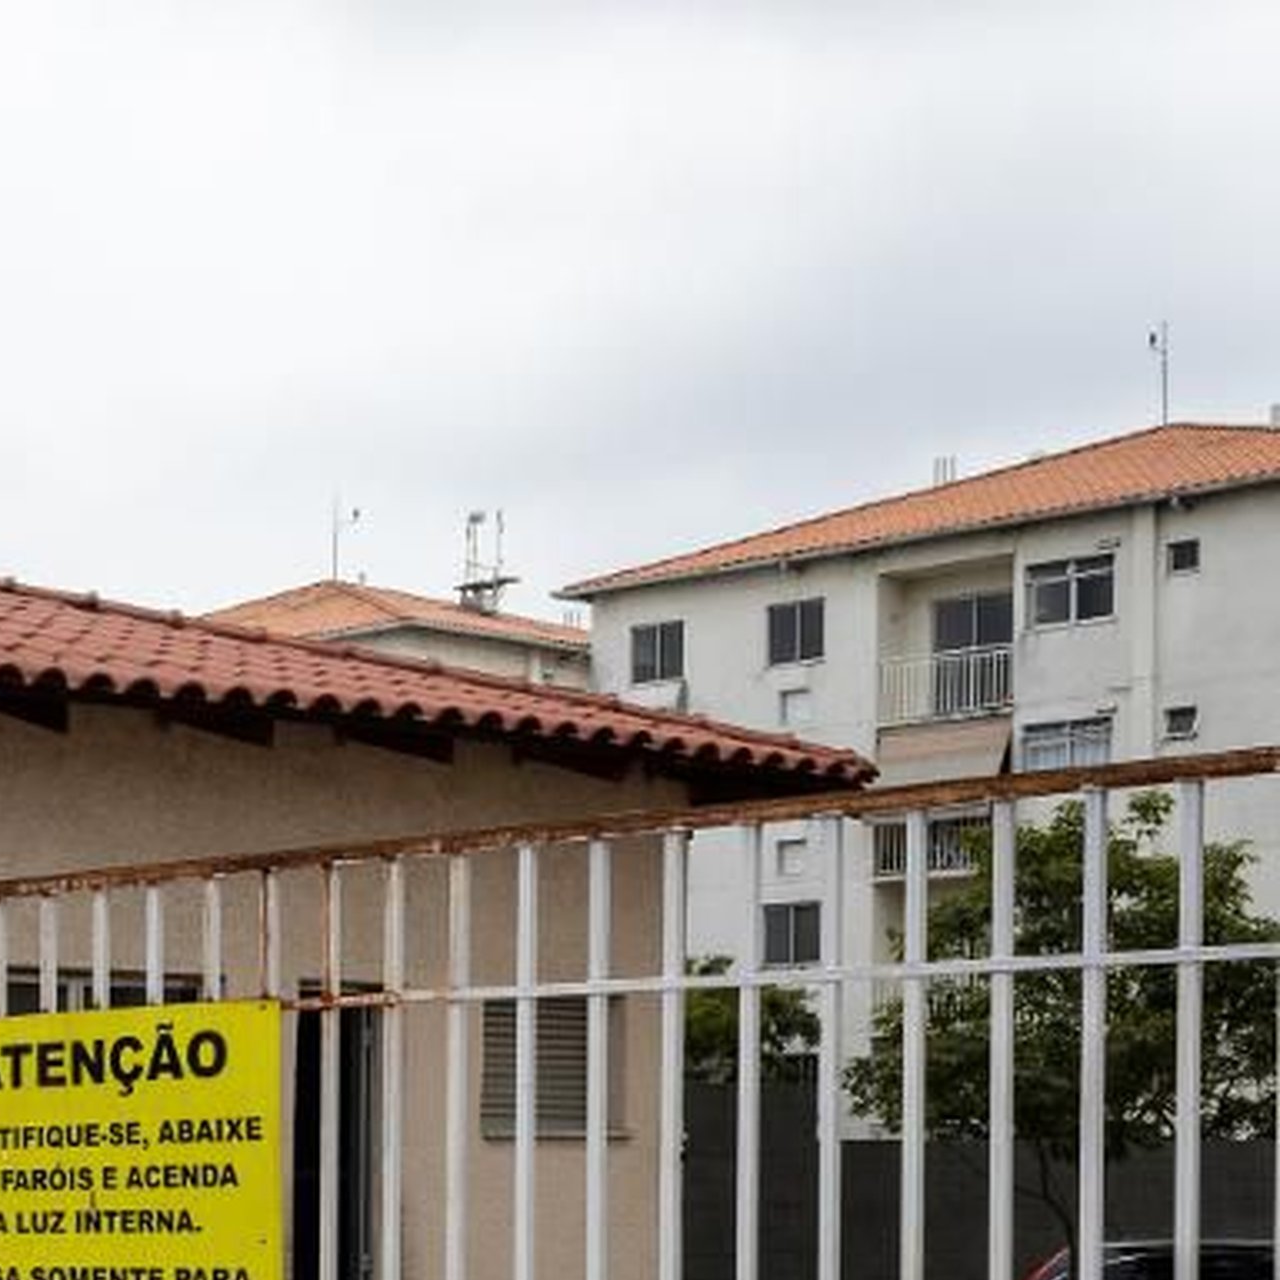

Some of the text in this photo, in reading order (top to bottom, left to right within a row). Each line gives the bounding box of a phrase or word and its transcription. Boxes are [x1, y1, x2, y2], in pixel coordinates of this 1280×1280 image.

[158, 1115, 263, 1144] ABAIXE
[1, 1161, 95, 1192] FARÓIS
[102, 1166, 118, 1190] E
[126, 1162, 239, 1190] ACENDA
[16, 1210, 67, 1235] LUZ
[75, 1208, 203, 1234] INTERNA.
